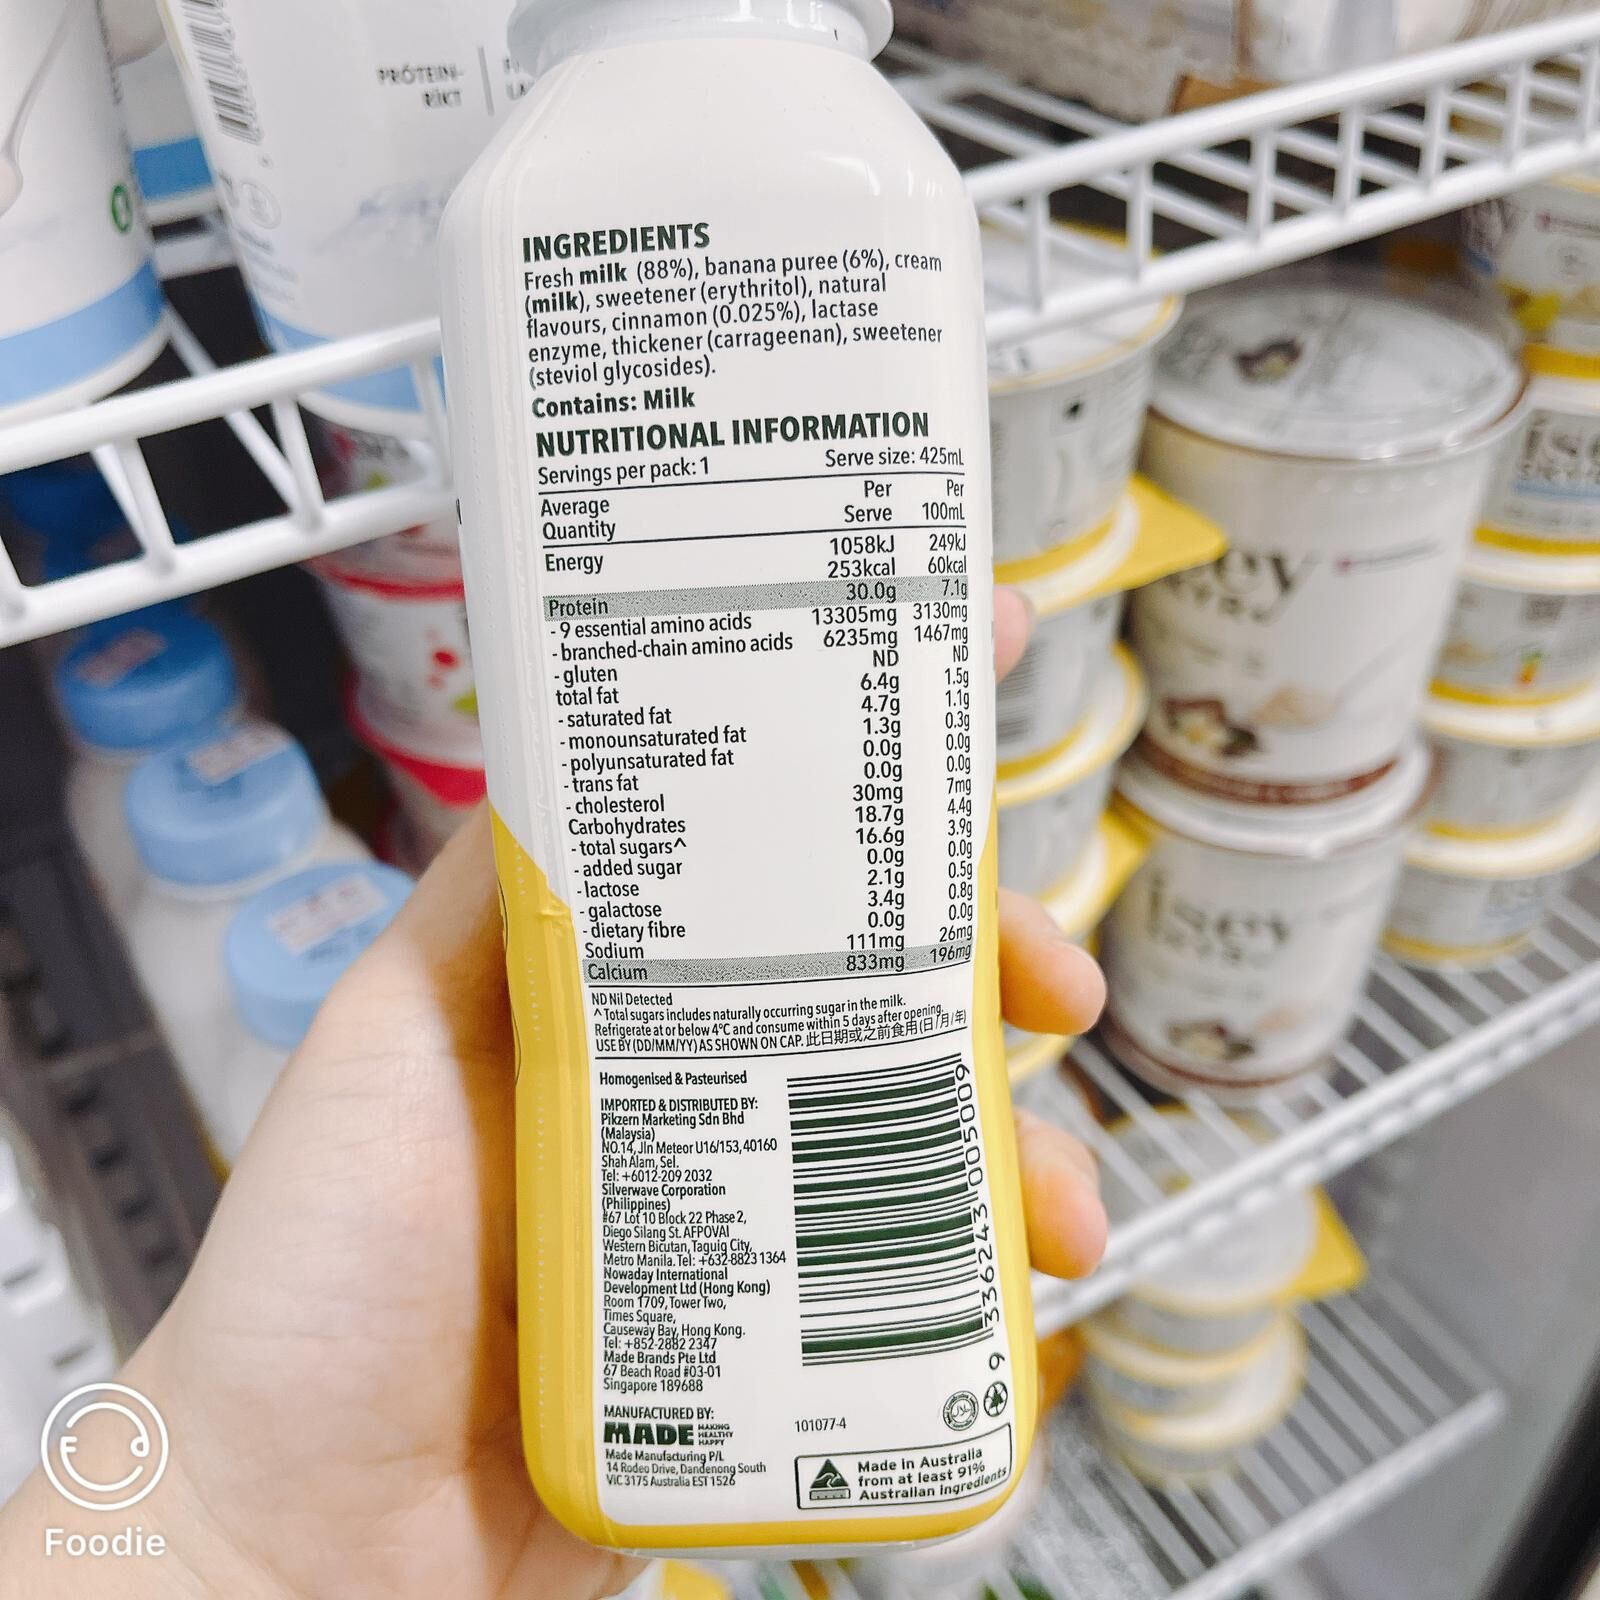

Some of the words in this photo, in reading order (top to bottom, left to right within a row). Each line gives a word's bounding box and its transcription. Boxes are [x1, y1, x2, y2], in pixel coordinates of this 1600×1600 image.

[522, 222, 710, 262] INGREDIENTS
[524, 266, 573, 290] Fresh
[579, 262, 627, 285] milk
[637, 258, 699, 284] (88%),
[704, 256, 776, 276] banana
[782, 255, 837, 277] puree
[842, 251, 889, 272] (6%),
[895, 254, 941, 271] cream
[524, 290, 590, 318] (milk),
[595, 287, 696, 308] sweetener
[700, 276, 812, 304] (erythritol),
[819, 273, 885, 294] natural
[526, 318, 606, 338] flavours,
[612, 311, 707, 331] cinnamon
[712, 300, 805, 328] (0.025%),
[812, 300, 878, 318] lactase
[528, 343, 606, 363] enzyme,
[611, 333, 703, 355] thickener
[707, 323, 847, 352] (carrageenan),
[852, 323, 942, 342] sweetener
[529, 361, 597, 389] (steviol
[603, 356, 715, 385] glycosides).
[532, 392, 637, 418] Contains:
[643, 386, 695, 410] Milk
[535, 421, 725, 458] NUTRITIONAL
[732, 412, 928, 445] INFORMATION
[825, 449, 874, 467] Serve
[878, 450, 915, 465] size:
[919, 446, 964, 465] 425mL
[538, 464, 611, 486] Servings
[616, 464, 645, 485] per
[864, 480, 892, 498] Per
[946, 479, 964, 496] Per
[540, 499, 609, 517] Average
[844, 504, 892, 523] Serve
[922, 501, 965, 520] 100mL
[542, 519, 615, 540] Quantity
[830, 534, 894, 555] 1058kJ
[929, 532, 966, 551] 249kJ
[545, 553, 603, 574] Energy
[827, 557, 895, 578] 253kcal
[927, 555, 966, 574] 60kcal
[548, 598, 609, 618] Protein
[845, 582, 897, 603] 30.0g
[942, 579, 968, 598] 7.1g
[811, 605, 897, 626] 13305mg
[913, 602, 967, 622] 3130mg
[574, 617, 646, 638] essential
[650, 615, 704, 634] amino
[709, 612, 751, 631] acids
[914, 624, 968, 644] 1467mg
[691, 639, 746, 655] amino
[750, 633, 793, 652] acids
[823, 628, 897, 649] 6235mg
[873, 649, 899, 667] ND
[953, 644, 968, 662] ND
[860, 672, 899, 694] 6.4g
[944, 667, 969, 688] 1.5g
[555, 686, 592, 706] total
[596, 685, 619, 704] fat
[861, 694, 900, 716] 4.7g
[945, 689, 969, 710] 1.1g
[648, 707, 672, 724] fat
[945, 710, 970, 731] 0.3g
[722, 726, 747, 743] fat
[863, 716, 901, 738] 1.3g
[863, 738, 901, 760] 0.0g
[945, 732, 970, 753] 0.0g
[710, 748, 734, 766] fat
[946, 754, 971, 774] 0.0g
[864, 760, 902, 782] 0.0g
[616, 773, 639, 791] fat
[946, 777, 971, 795] 7mg
[852, 783, 903, 804] 30mg
[855, 804, 904, 826] 18.7g
[947, 796, 971, 817] 4.4g
[568, 815, 685, 838] Carbohydrates
[855, 826, 904, 846] 16.6g
[947, 817, 972, 838] 3.9g
[867, 847, 904, 867] 0.0g
[948, 839, 972, 859] 0.0g
[637, 862, 682, 880] sugar
[867, 867, 904, 888] 2.1g
[948, 860, 972, 880] 0.5g
[867, 889, 904, 909] 3.4g
[948, 881, 972, 901] 0.8g
[867, 910, 904, 931] 0.0g
[948, 902, 973, 921] 0.0g
[647, 920, 685, 938] fibre
[939, 924, 972, 943] 26mg
[584, 941, 644, 963] Sodium
[846, 932, 905, 953] 111mg
[588, 963, 648, 981] Calcium
[846, 954, 905, 972] 833mg
[931, 943, 971, 963] 196mg
[604, 1422, 694, 1446] MADE
[858, 1459, 896, 1473] Made
[920, 1447, 983, 1468] Australia
[858, 1474, 893, 1487] from
[898, 1472, 912, 1484] at
[918, 1470, 953, 1483] least
[957, 1461, 985, 1479] 91%
[859, 1487, 935, 1501] Australian
[939, 1466, 1007, 1496] ingredients
